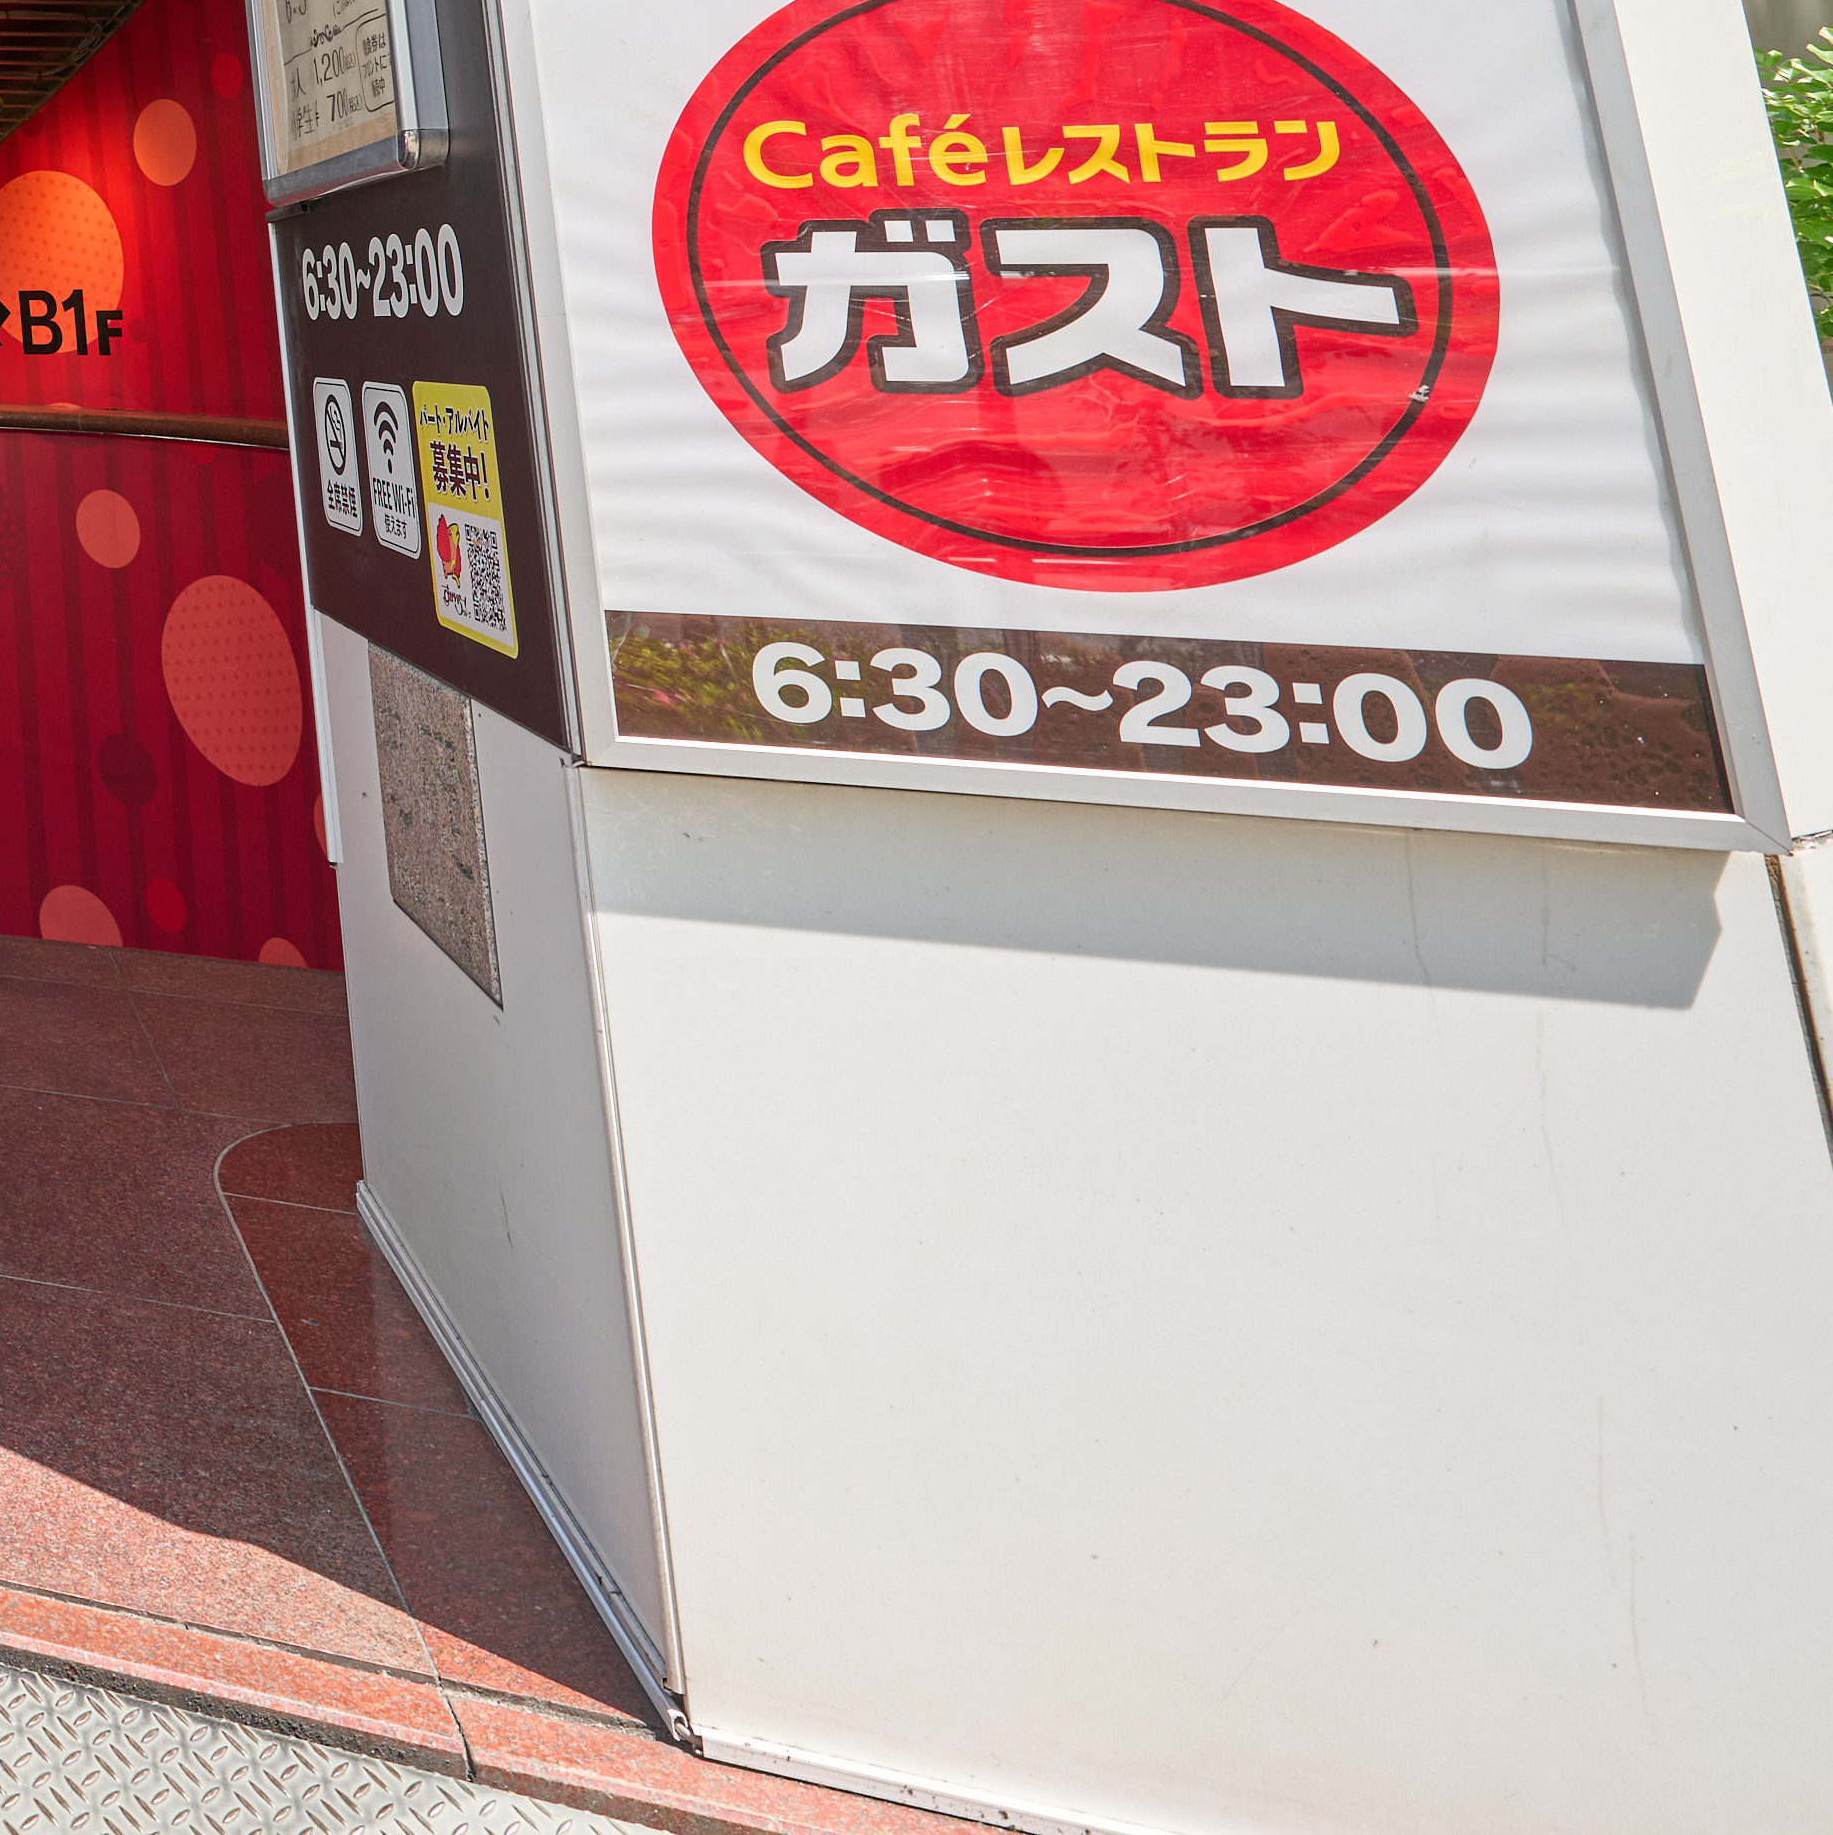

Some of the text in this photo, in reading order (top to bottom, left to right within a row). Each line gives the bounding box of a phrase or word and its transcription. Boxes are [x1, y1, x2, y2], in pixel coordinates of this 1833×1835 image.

[18, 288, 124, 356] B1F
[762, 209, 1417, 399] ガスト
[327, 479, 358, 518] 全席禁煙
[372, 477, 416, 518] FREE Wi-Fi
[384, 512, 407, 539] 使えます
